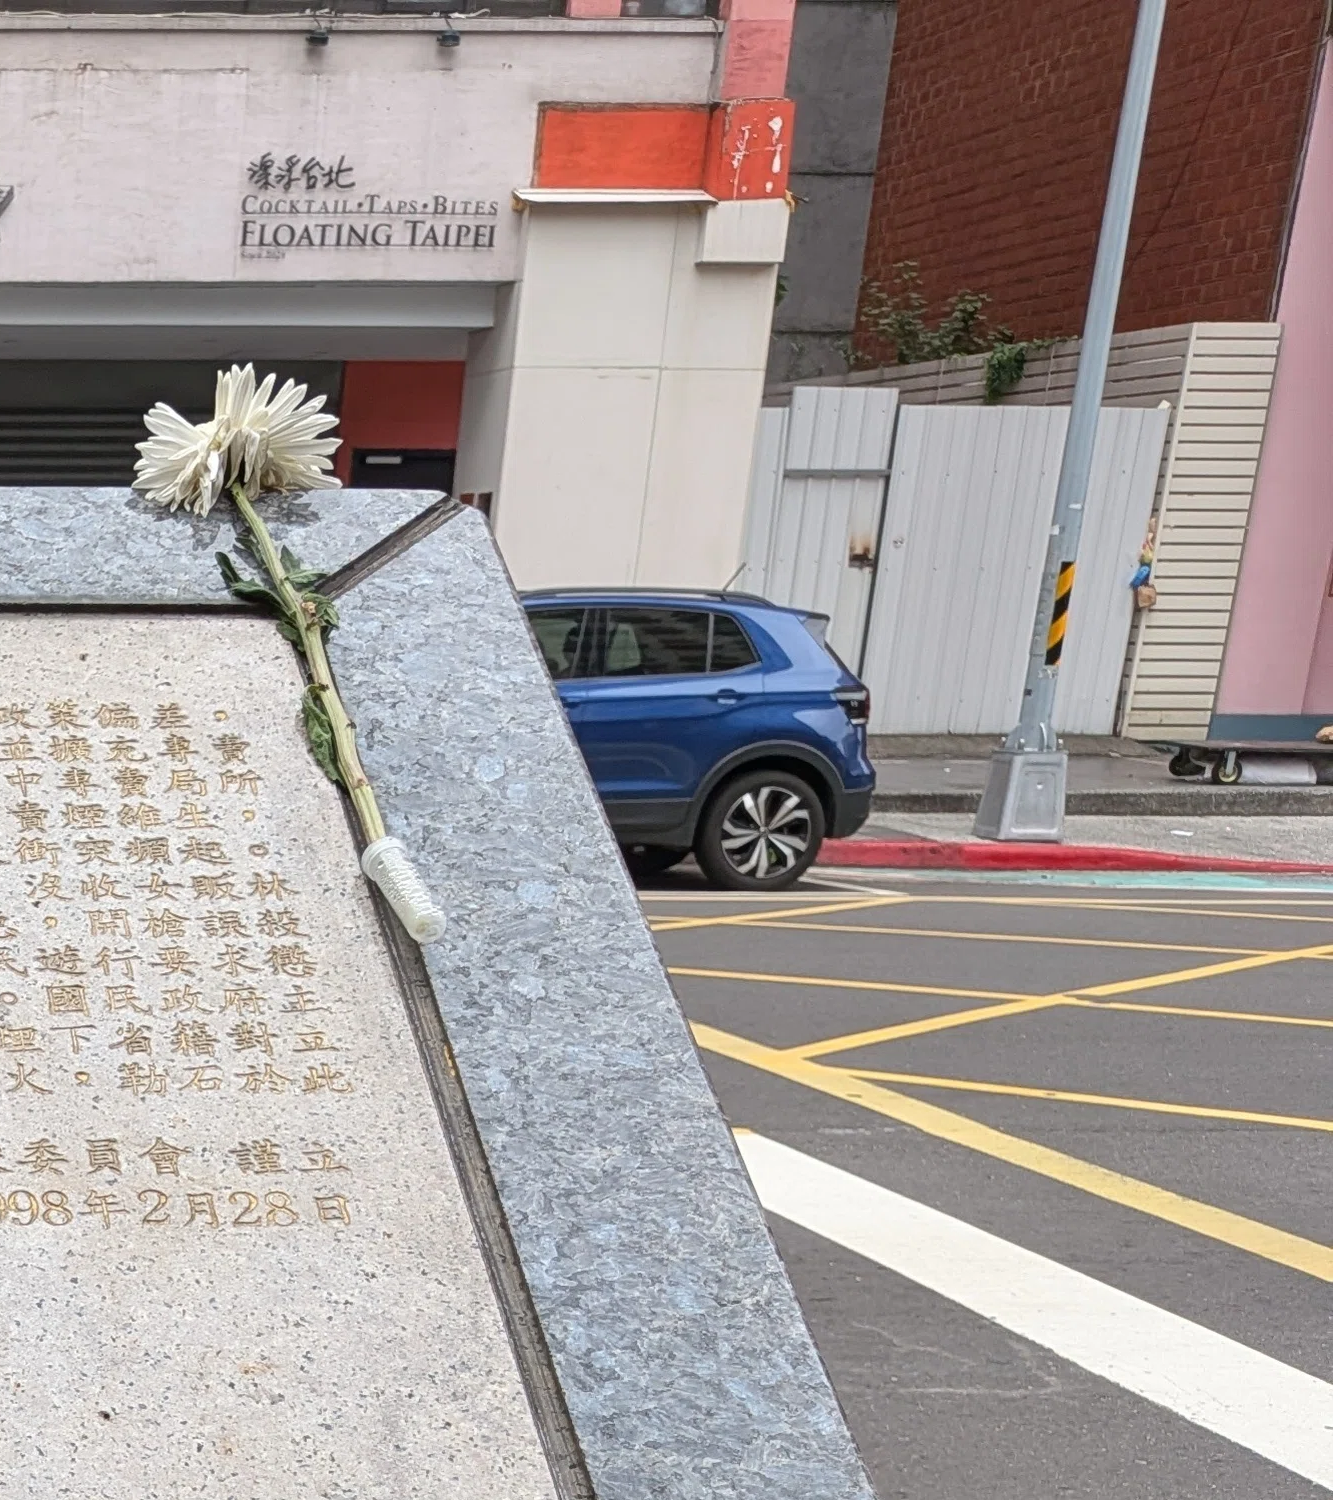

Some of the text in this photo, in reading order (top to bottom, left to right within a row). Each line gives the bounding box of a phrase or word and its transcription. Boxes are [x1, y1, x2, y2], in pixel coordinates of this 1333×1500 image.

[240, 220, 496, 248] FLOATING TAIPEI
[230, 1139, 353, 1181] 謹立
